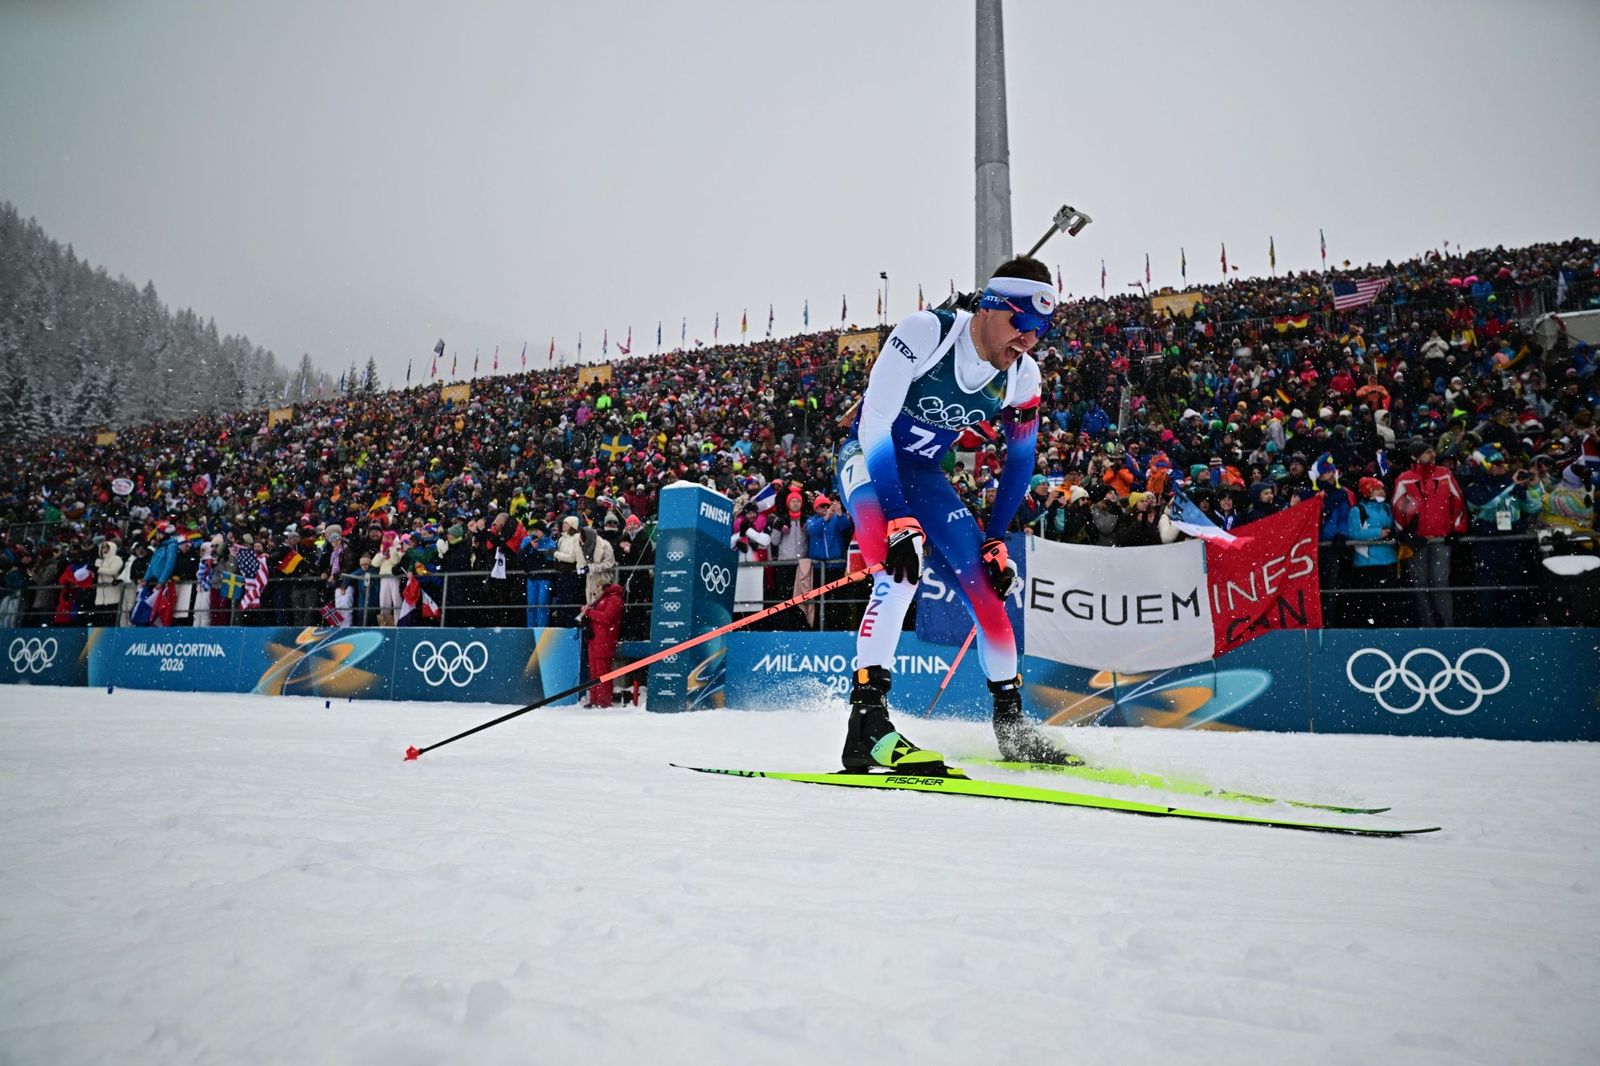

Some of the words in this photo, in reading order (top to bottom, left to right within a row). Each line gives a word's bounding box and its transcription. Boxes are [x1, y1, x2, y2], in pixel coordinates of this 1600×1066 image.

[890, 335, 918, 364] ATEX
[845, 464, 854, 484] 7
[699, 502, 731, 526] FINISH
[946, 507, 972, 523] ATE
[860, 581, 891, 637] CZE
[125, 643, 173, 657] MILANO
[174, 643, 225, 658] CORTINA
[160, 658, 184, 672] 2026
[752, 654, 847, 673] MILANO
[850, 655, 952, 674] CRTINA
[885, 776, 944, 787] FISCHER
